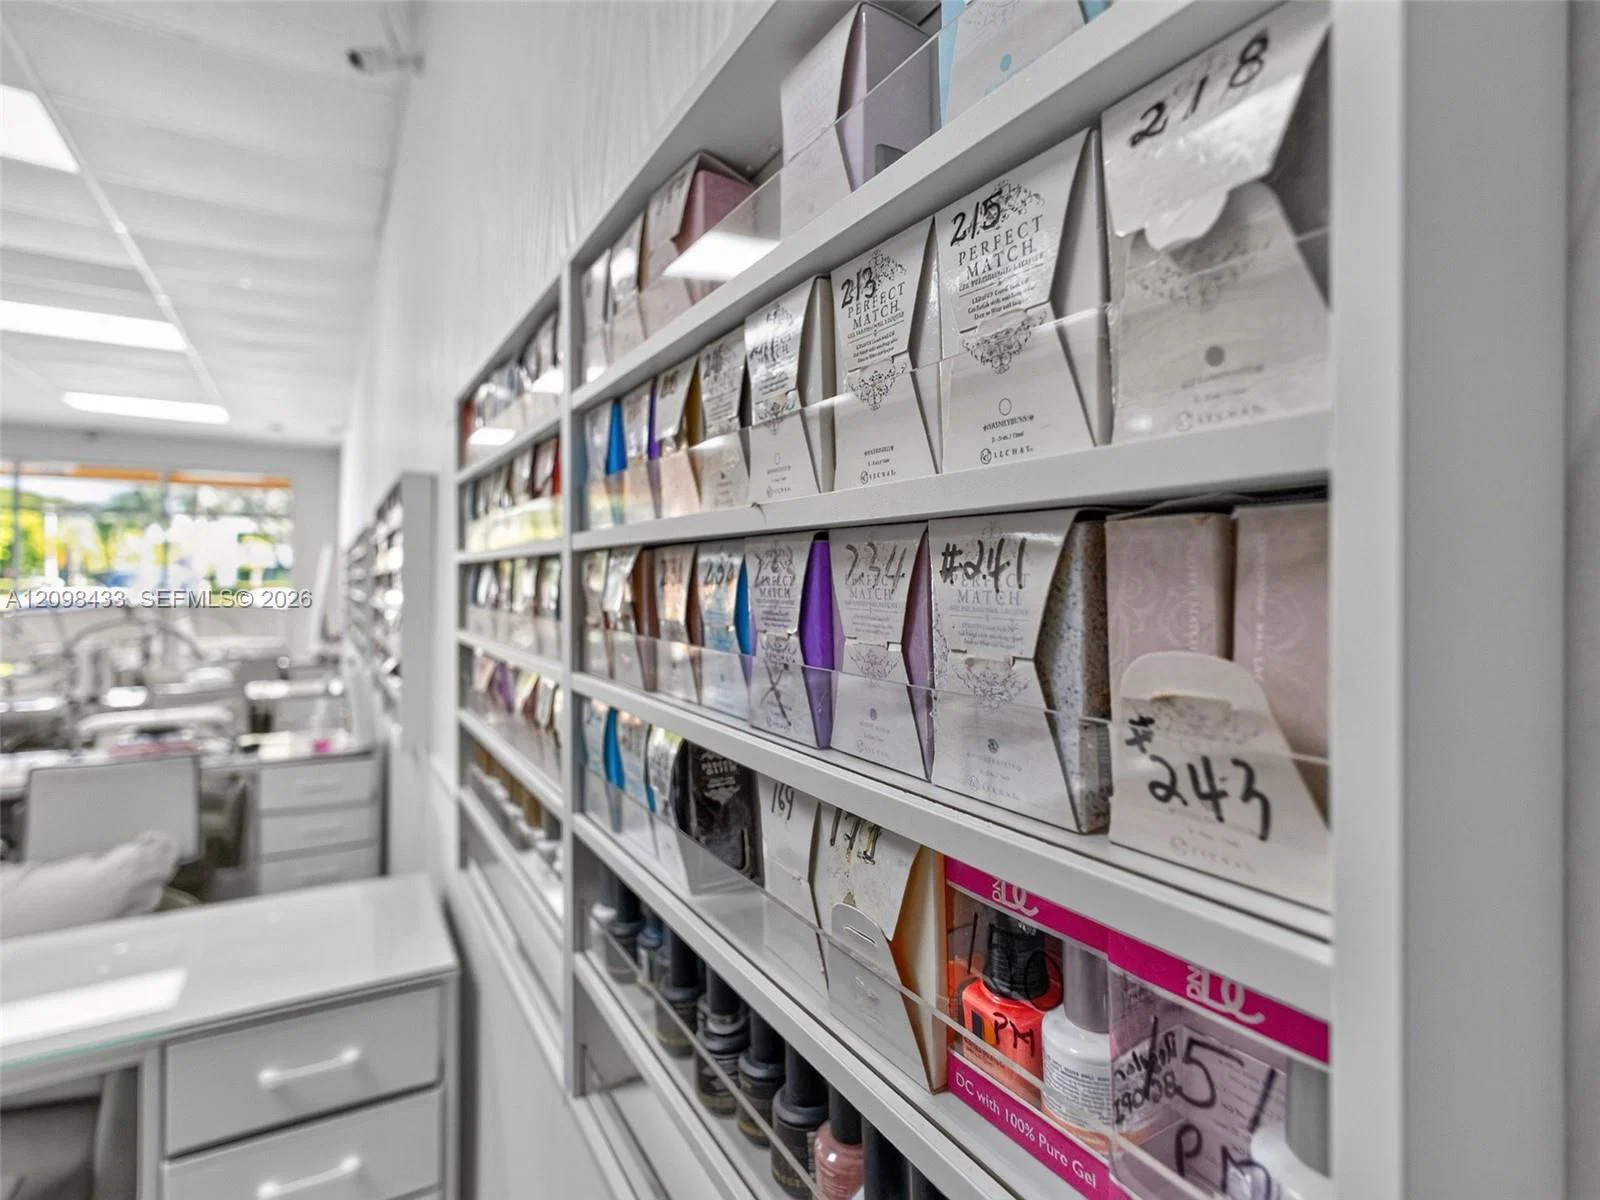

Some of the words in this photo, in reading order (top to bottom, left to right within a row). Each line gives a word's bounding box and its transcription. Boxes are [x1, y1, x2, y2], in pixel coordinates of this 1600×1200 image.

[1128, 29, 1270, 149] 218
[950, 189, 1003, 247] 215
[959, 214, 1044, 266] PERFECT
[966, 238, 1035, 281] MATCH
[841, 266, 877, 309] 213
[848, 282, 906, 319] PERFECT
[852, 300, 899, 331] MATCH
[957, 589, 1022, 606] MATCH
[1148, 755, 1271, 842] 243
[993, 1011, 1035, 1058] PM
[956, 1072, 975, 1096] DC
[977, 1091, 1000, 1116] with
[1004, 1109, 1035, 1143] 100%
[1038, 1132, 1069, 1168] Pure
[1072, 1160, 1096, 1190] Gel
